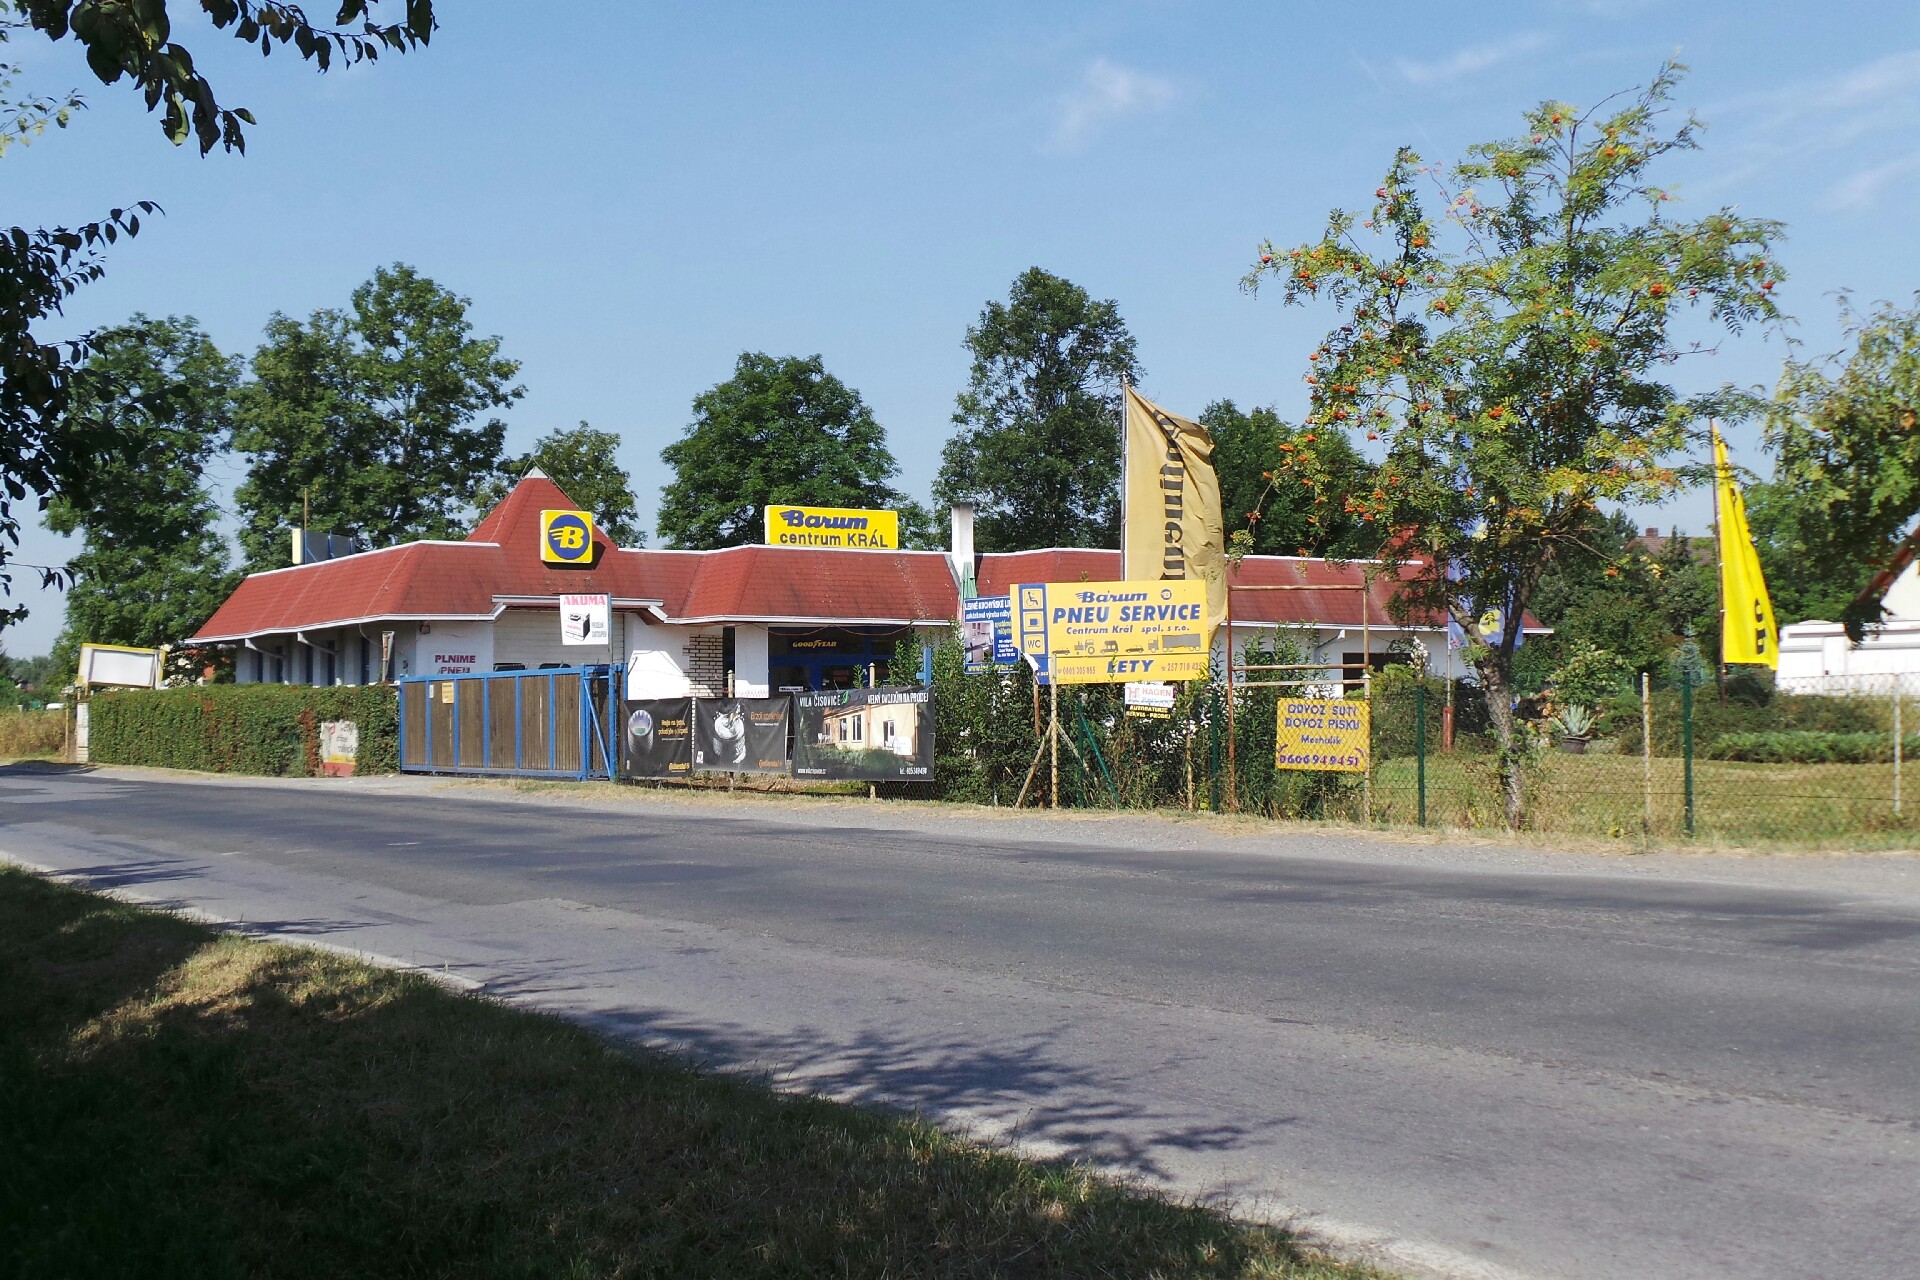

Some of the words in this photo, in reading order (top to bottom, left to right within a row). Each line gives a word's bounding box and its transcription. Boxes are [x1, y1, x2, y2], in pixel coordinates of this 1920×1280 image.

[780, 510, 868, 529] Barum
[780, 532, 841, 545] centrum
[847, 529, 888, 548] KRÁL
[564, 595, 606, 606] AKUMA
[1076, 590, 1147, 603] Barum
[1053, 606, 1110, 624] PNEU
[1120, 604, 1201, 622] SERVICE
[1066, 626, 1108, 635] Centrum
[1112, 624, 1133, 634] Král
[1141, 624, 1164, 635] spol.
[1027, 639, 1041, 649] WC
[1106, 660, 1154, 673] LETY
[1288, 703, 1326, 715] ODVOZ
[1286, 718, 1323, 729] DOVOZ
